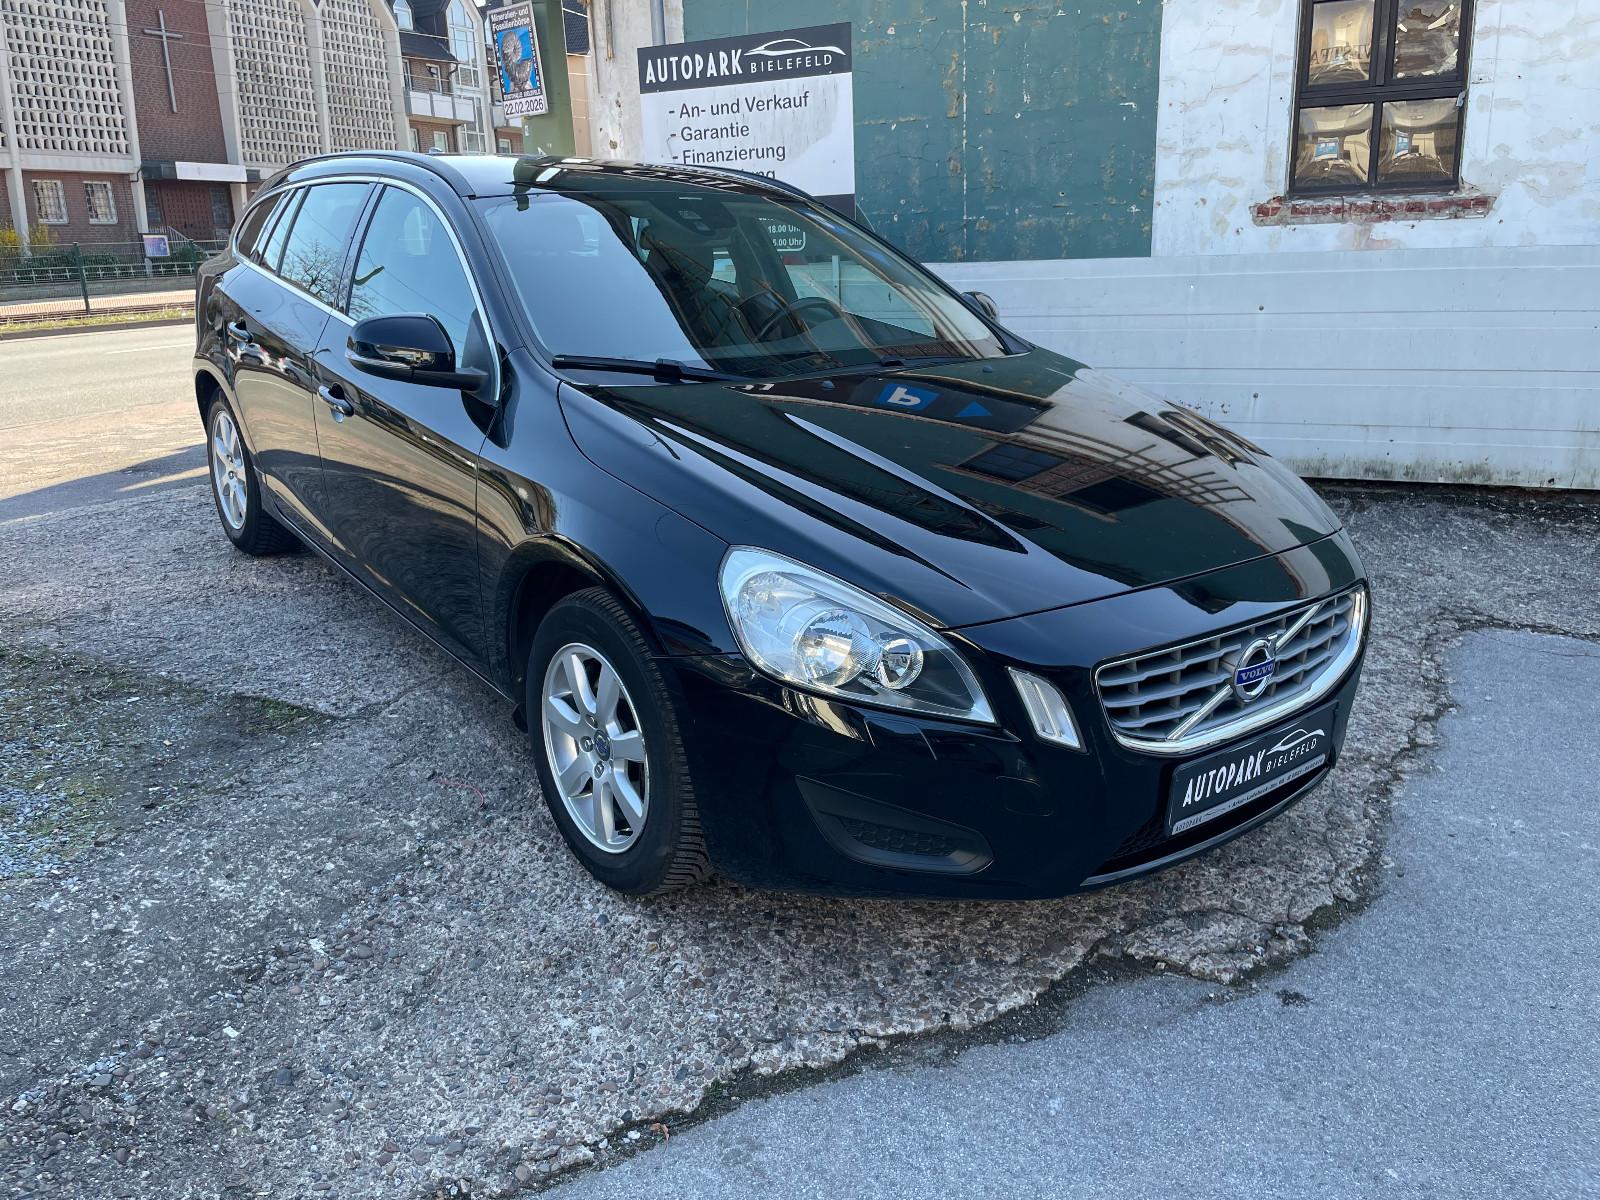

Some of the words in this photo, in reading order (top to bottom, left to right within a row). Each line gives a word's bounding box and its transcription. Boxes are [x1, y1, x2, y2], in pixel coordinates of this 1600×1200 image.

[518, 6, 529, 16] und
[645, 48, 743, 84] AUTOPARK
[750, 54, 833, 74] BIELEFELD
[505, 98, 544, 115] 22.02.2026
[679, 103, 706, 119] An-
[710, 98, 740, 116] und
[744, 91, 810, 113] Verkauf
[680, 122, 750, 142] Garantie
[683, 145, 786, 165] Finanzierung
[768, 225, 786, 233] 18.00
[789, 238, 802, 246] Uhr
[1240, 663, 1274, 681] VOLVO
[1182, 749, 1266, 808] AUTOPARK
[1265, 737, 1318, 773] BIELEFELD
